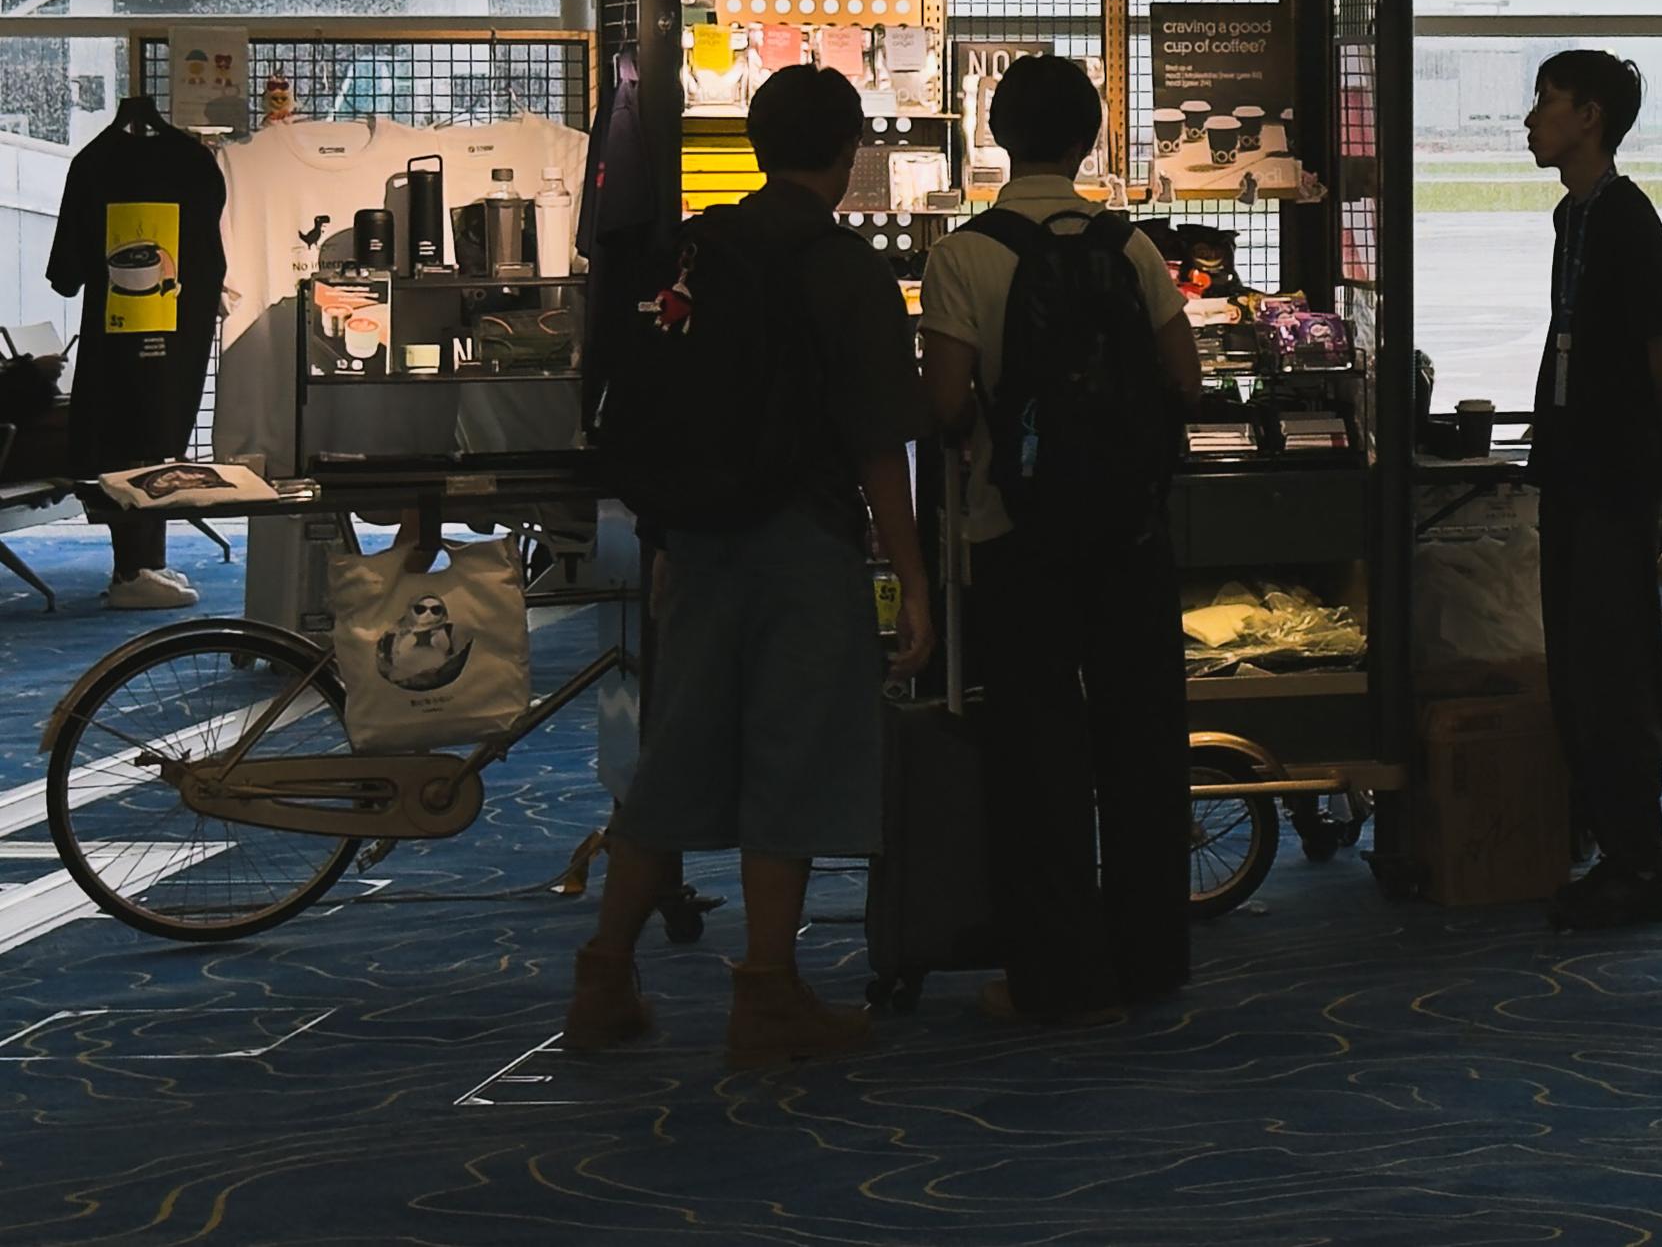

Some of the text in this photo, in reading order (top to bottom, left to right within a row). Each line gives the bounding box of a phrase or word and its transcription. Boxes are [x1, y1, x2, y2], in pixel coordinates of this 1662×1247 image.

[1163, 20, 1272, 37] craving a good
[1163, 38, 1267, 56] cup of coffee?
[292, 261, 308, 272] No
